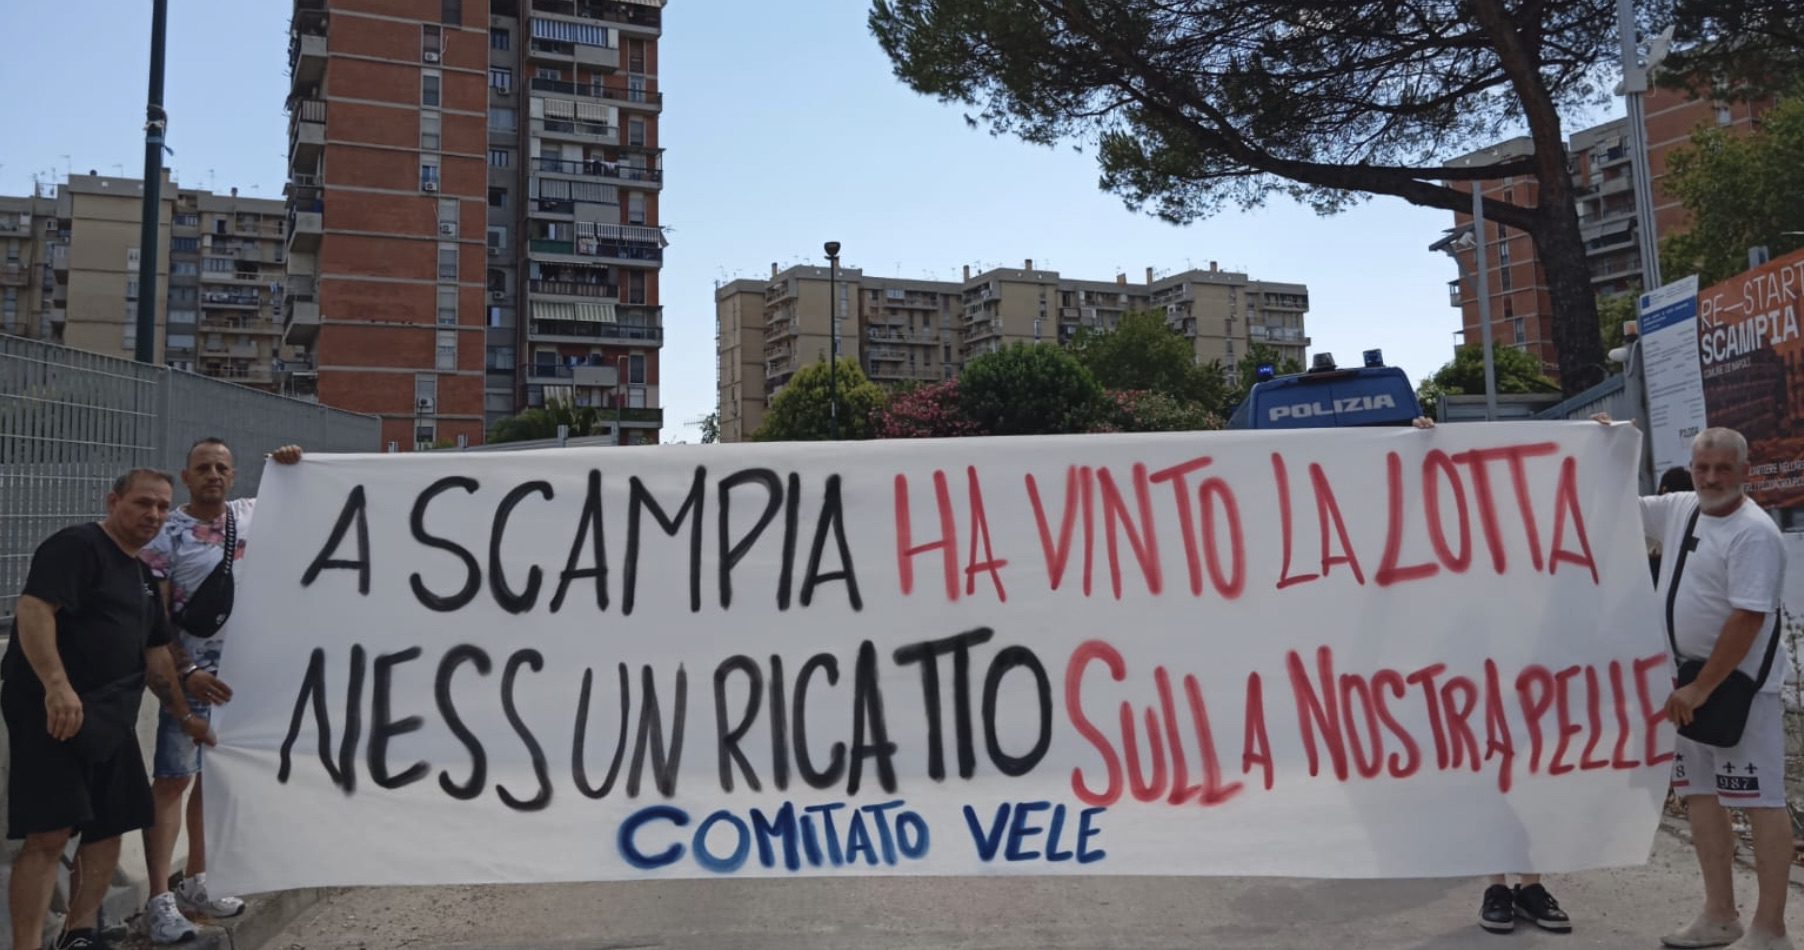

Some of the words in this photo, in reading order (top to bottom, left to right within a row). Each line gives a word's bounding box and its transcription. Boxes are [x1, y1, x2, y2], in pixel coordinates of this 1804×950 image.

[1702, 305, 1799, 365] SCAMPIA
[1269, 394, 1396, 421] POLIZIA
[300, 483, 371, 596] A
[408, 464, 864, 616] SCAMPIA
[893, 464, 1009, 602] HA
[1024, 455, 1247, 600] VINTO
[1271, 452, 1366, 590] LA
[1374, 442, 1599, 588] LOTTA
[712, 626, 1054, 797] RICATTO
[1063, 638, 1276, 809] SULLA
[1286, 644, 1515, 795] NOSTRA
[1515, 653, 1675, 777] PELLE
[617, 799, 931, 874] COMITATO
[963, 800, 1107, 865] VELE
